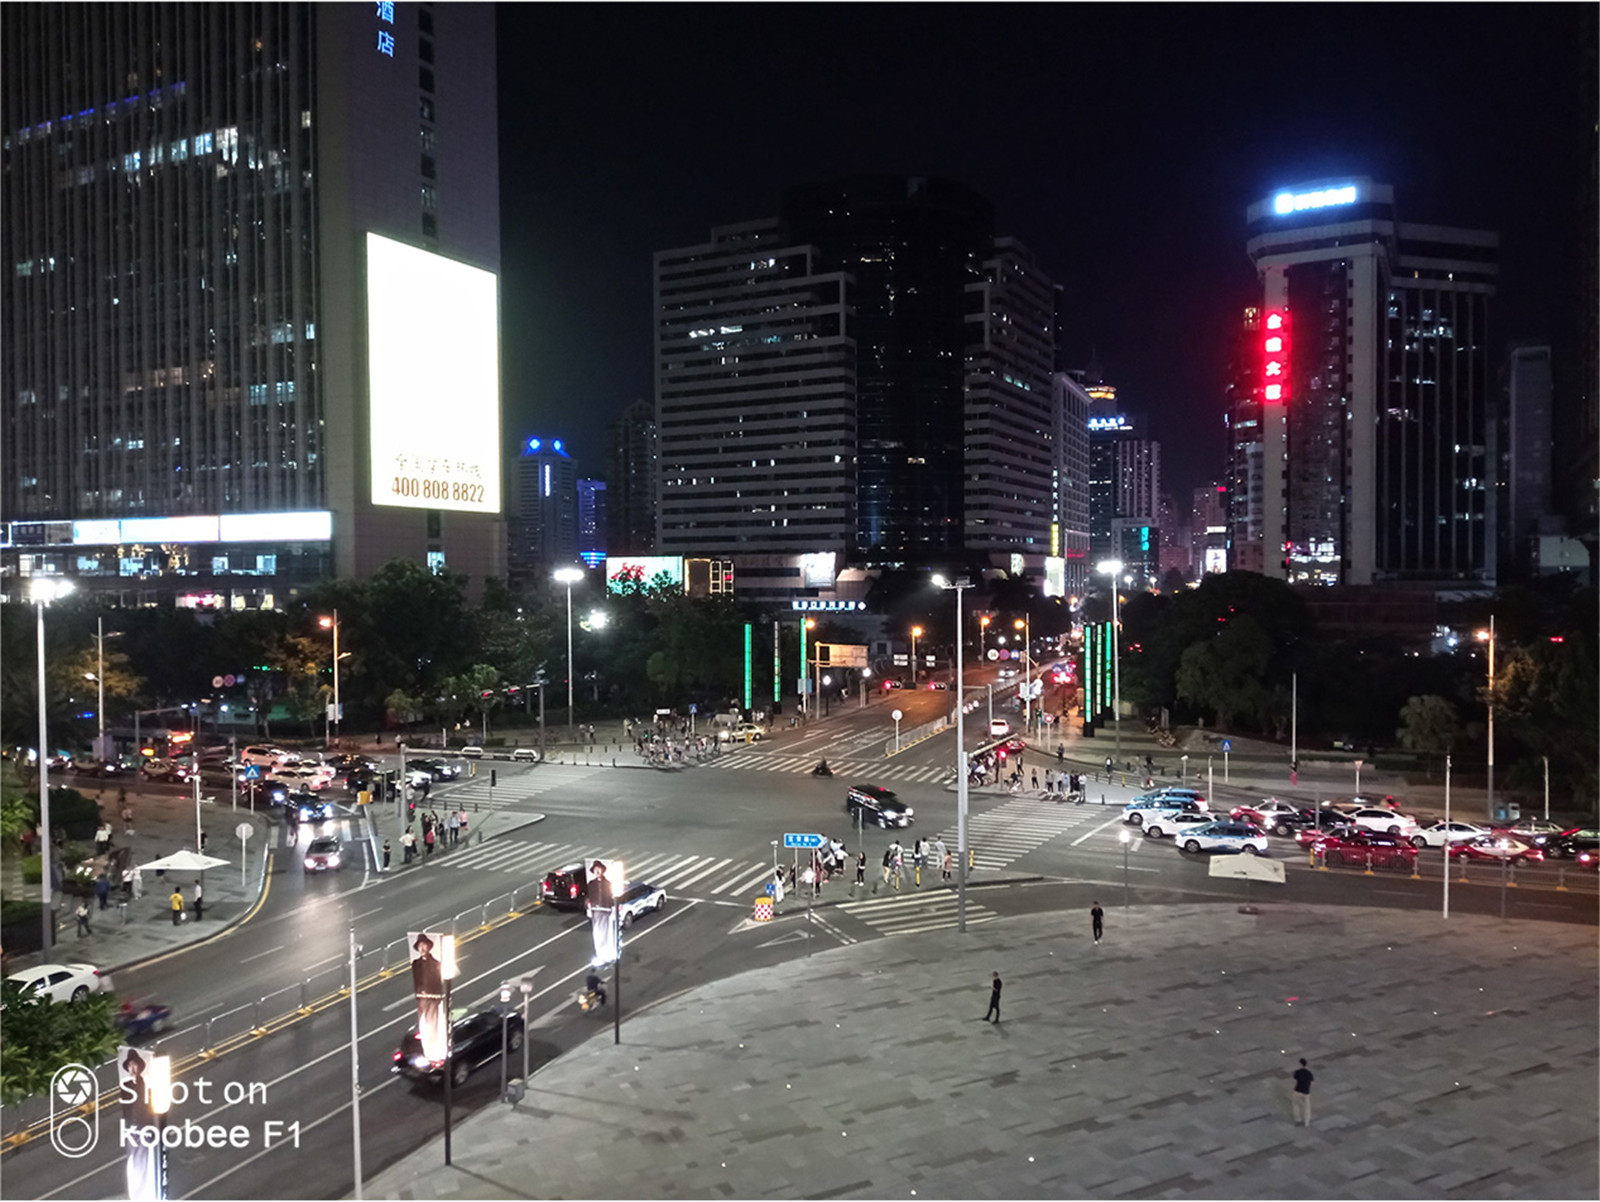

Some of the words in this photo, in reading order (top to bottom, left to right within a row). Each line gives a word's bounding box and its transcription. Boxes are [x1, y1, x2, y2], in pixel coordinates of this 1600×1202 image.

[376, 2, 395, 58] 酒店
[392, 476, 419, 498] 400
[423, 479, 449, 500] 808
[452, 481, 485, 503] 8822
